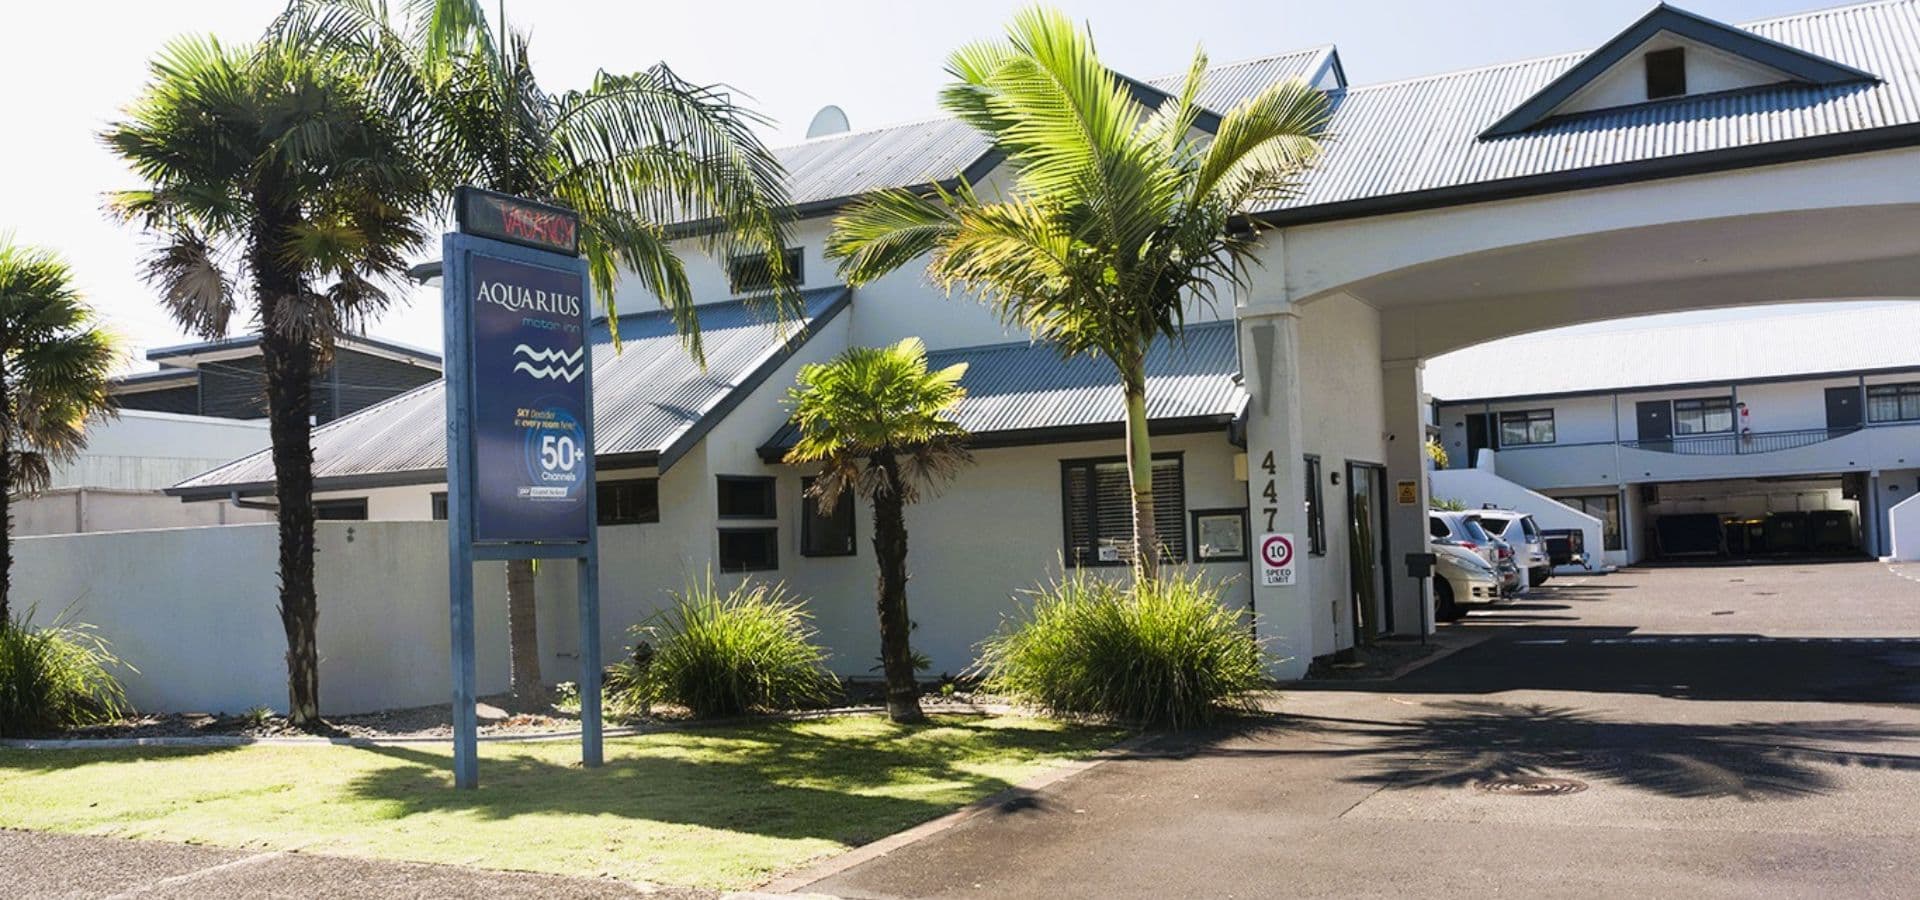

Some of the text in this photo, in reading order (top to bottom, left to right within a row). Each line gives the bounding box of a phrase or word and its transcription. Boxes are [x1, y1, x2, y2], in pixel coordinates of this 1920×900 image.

[477, 281, 580, 317] AQUARIUS
[522, 317, 580, 333] motor inn
[522, 420, 541, 430] every
[541, 472, 576, 481] Channels
[1270, 546, 1286, 558] 10
